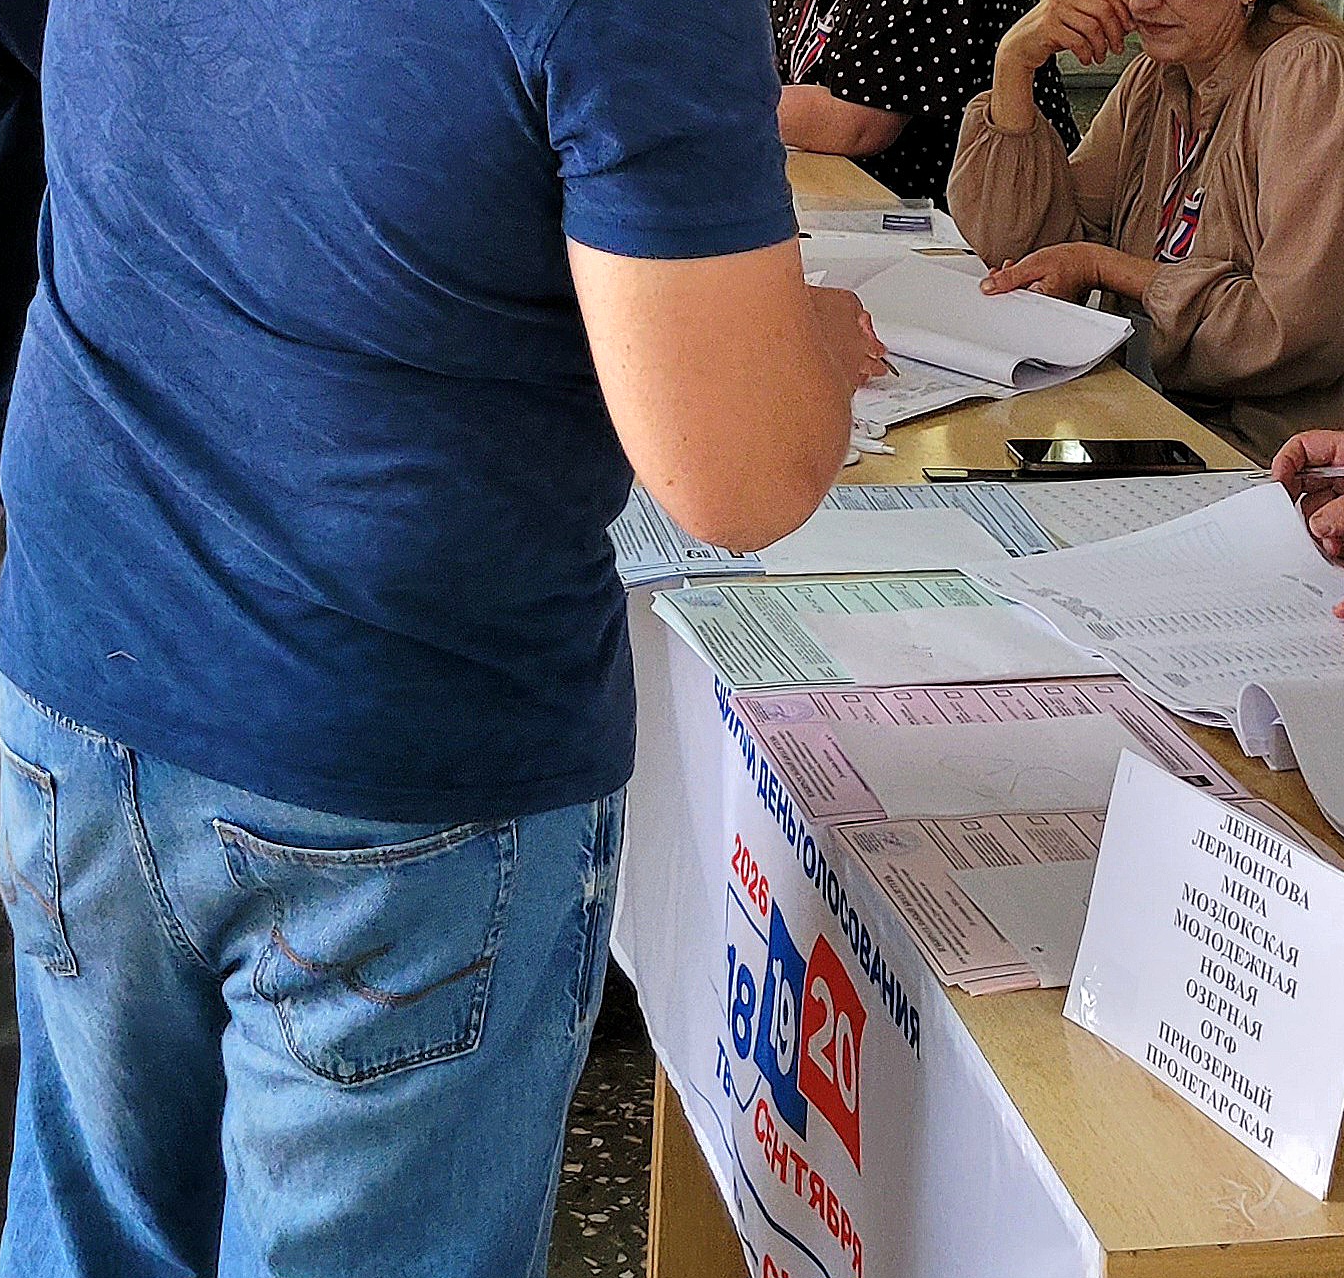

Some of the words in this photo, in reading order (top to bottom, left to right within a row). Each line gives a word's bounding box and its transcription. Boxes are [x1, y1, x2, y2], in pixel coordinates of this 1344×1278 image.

[731, 833, 770, 917] 2026
[1191, 829, 1311, 911] ЛЕРМОНТОВА
[1219, 814, 1294, 869] ЛЕНИНА
[757, 755, 796, 847] ДЕНЬ
[796, 818, 920, 1060] ГОЛОСОВАНИЯ
[1181, 881, 1300, 968] МОЗДОКСКАЯ
[1220, 873, 1268, 919] МИРА
[1173, 907, 1298, 1000] МОЛОДЕЖНАЯ
[1199, 955, 1260, 1007] НОВАЯ
[769, 957, 795, 1075] 19
[808, 976, 857, 1114] 20
[1185, 977, 1264, 1042] ОЗЕРНАЯ
[1199, 1018, 1240, 1055] ОТФ
[1145, 1042, 1275, 1150] ПРОЛЕТАРСКАЯ
[1157, 1020, 1273, 1114] ПРИОЗЕРНЫЙ
[754, 1098, 862, 1278] СЕНТЯБРЯ
